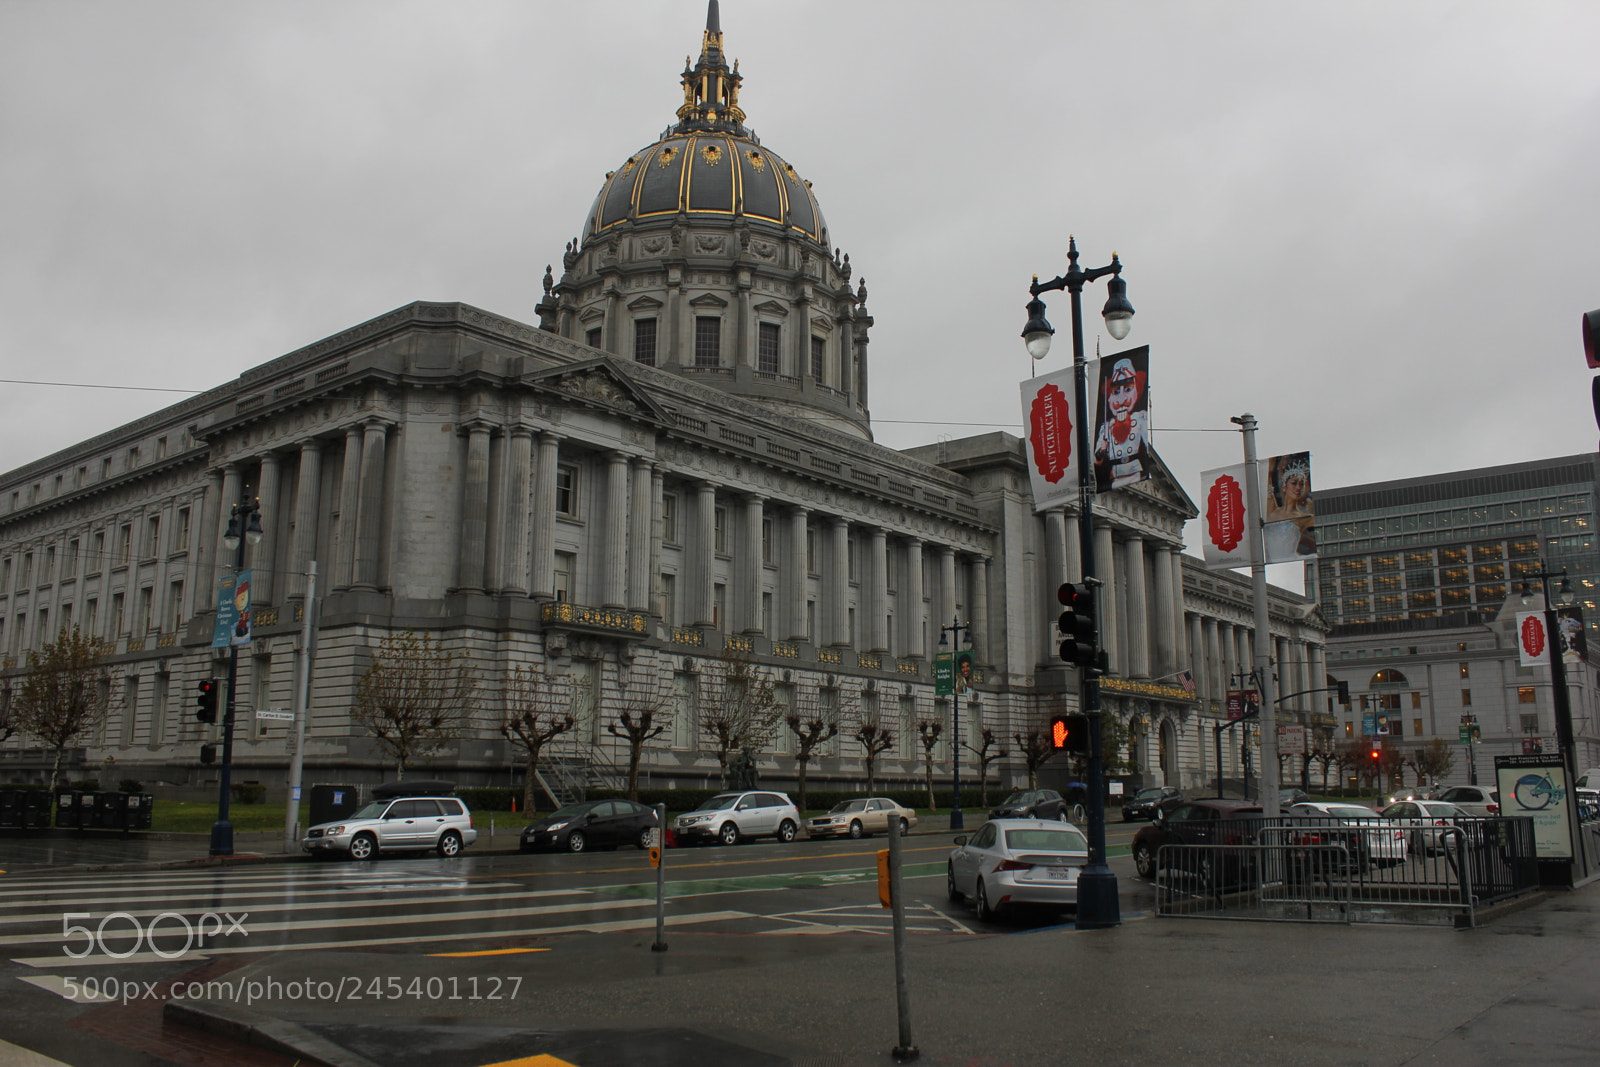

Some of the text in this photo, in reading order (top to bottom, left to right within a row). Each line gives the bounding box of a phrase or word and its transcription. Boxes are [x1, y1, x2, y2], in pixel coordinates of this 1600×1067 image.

[1044, 392, 1057, 474] NUTCRACKER
[1220, 482, 1231, 544] NUTCRACKER
[1529, 619, 1537, 653] NUTCRACKER
